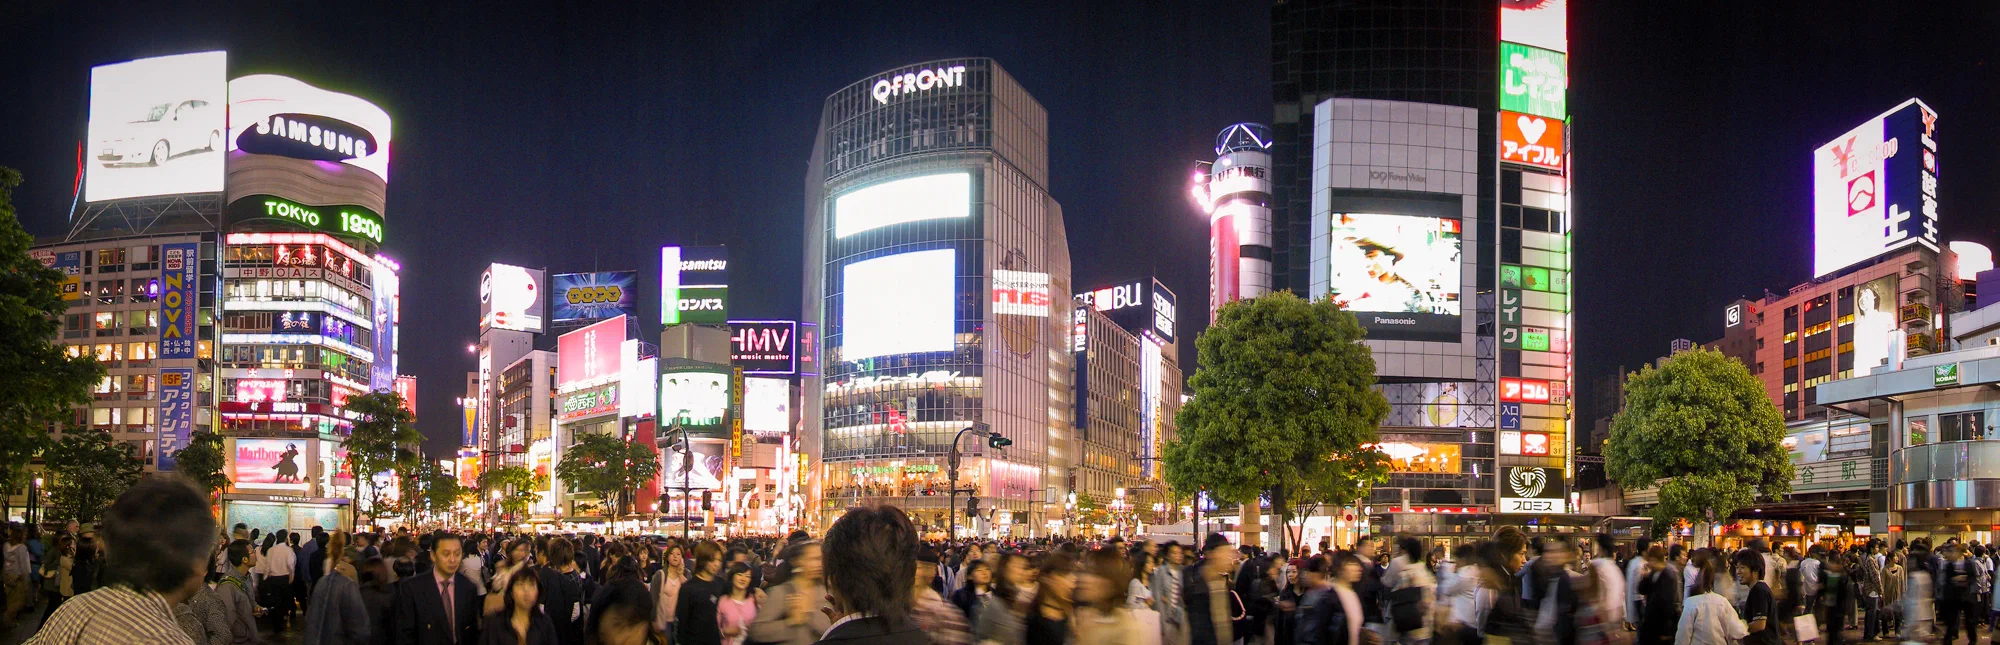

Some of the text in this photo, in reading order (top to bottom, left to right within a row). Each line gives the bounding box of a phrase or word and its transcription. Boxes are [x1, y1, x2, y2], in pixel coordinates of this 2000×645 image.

[873, 65, 966, 104] QFRONT
[1506, 69, 1563, 102] レイク
[256, 116, 367, 158] SAMSUNG
[1503, 140, 1561, 165] アイフル
[265, 201, 382, 243] TOKYO 19:00
[65, 284, 76, 292] 4F
[163, 273, 183, 338] NOVA
[1374, 316, 1416, 325] Panasonic
[1503, 290, 1518, 343] レイク
[180, 372, 191, 429] コンタクトの
[1505, 382, 1549, 400] アコム
[161, 389, 179, 459] アイシティ
[1502, 405, 1519, 416] 入口
[904, 465, 939, 473] COFFEE
[1513, 501, 1553, 512] プロミス
